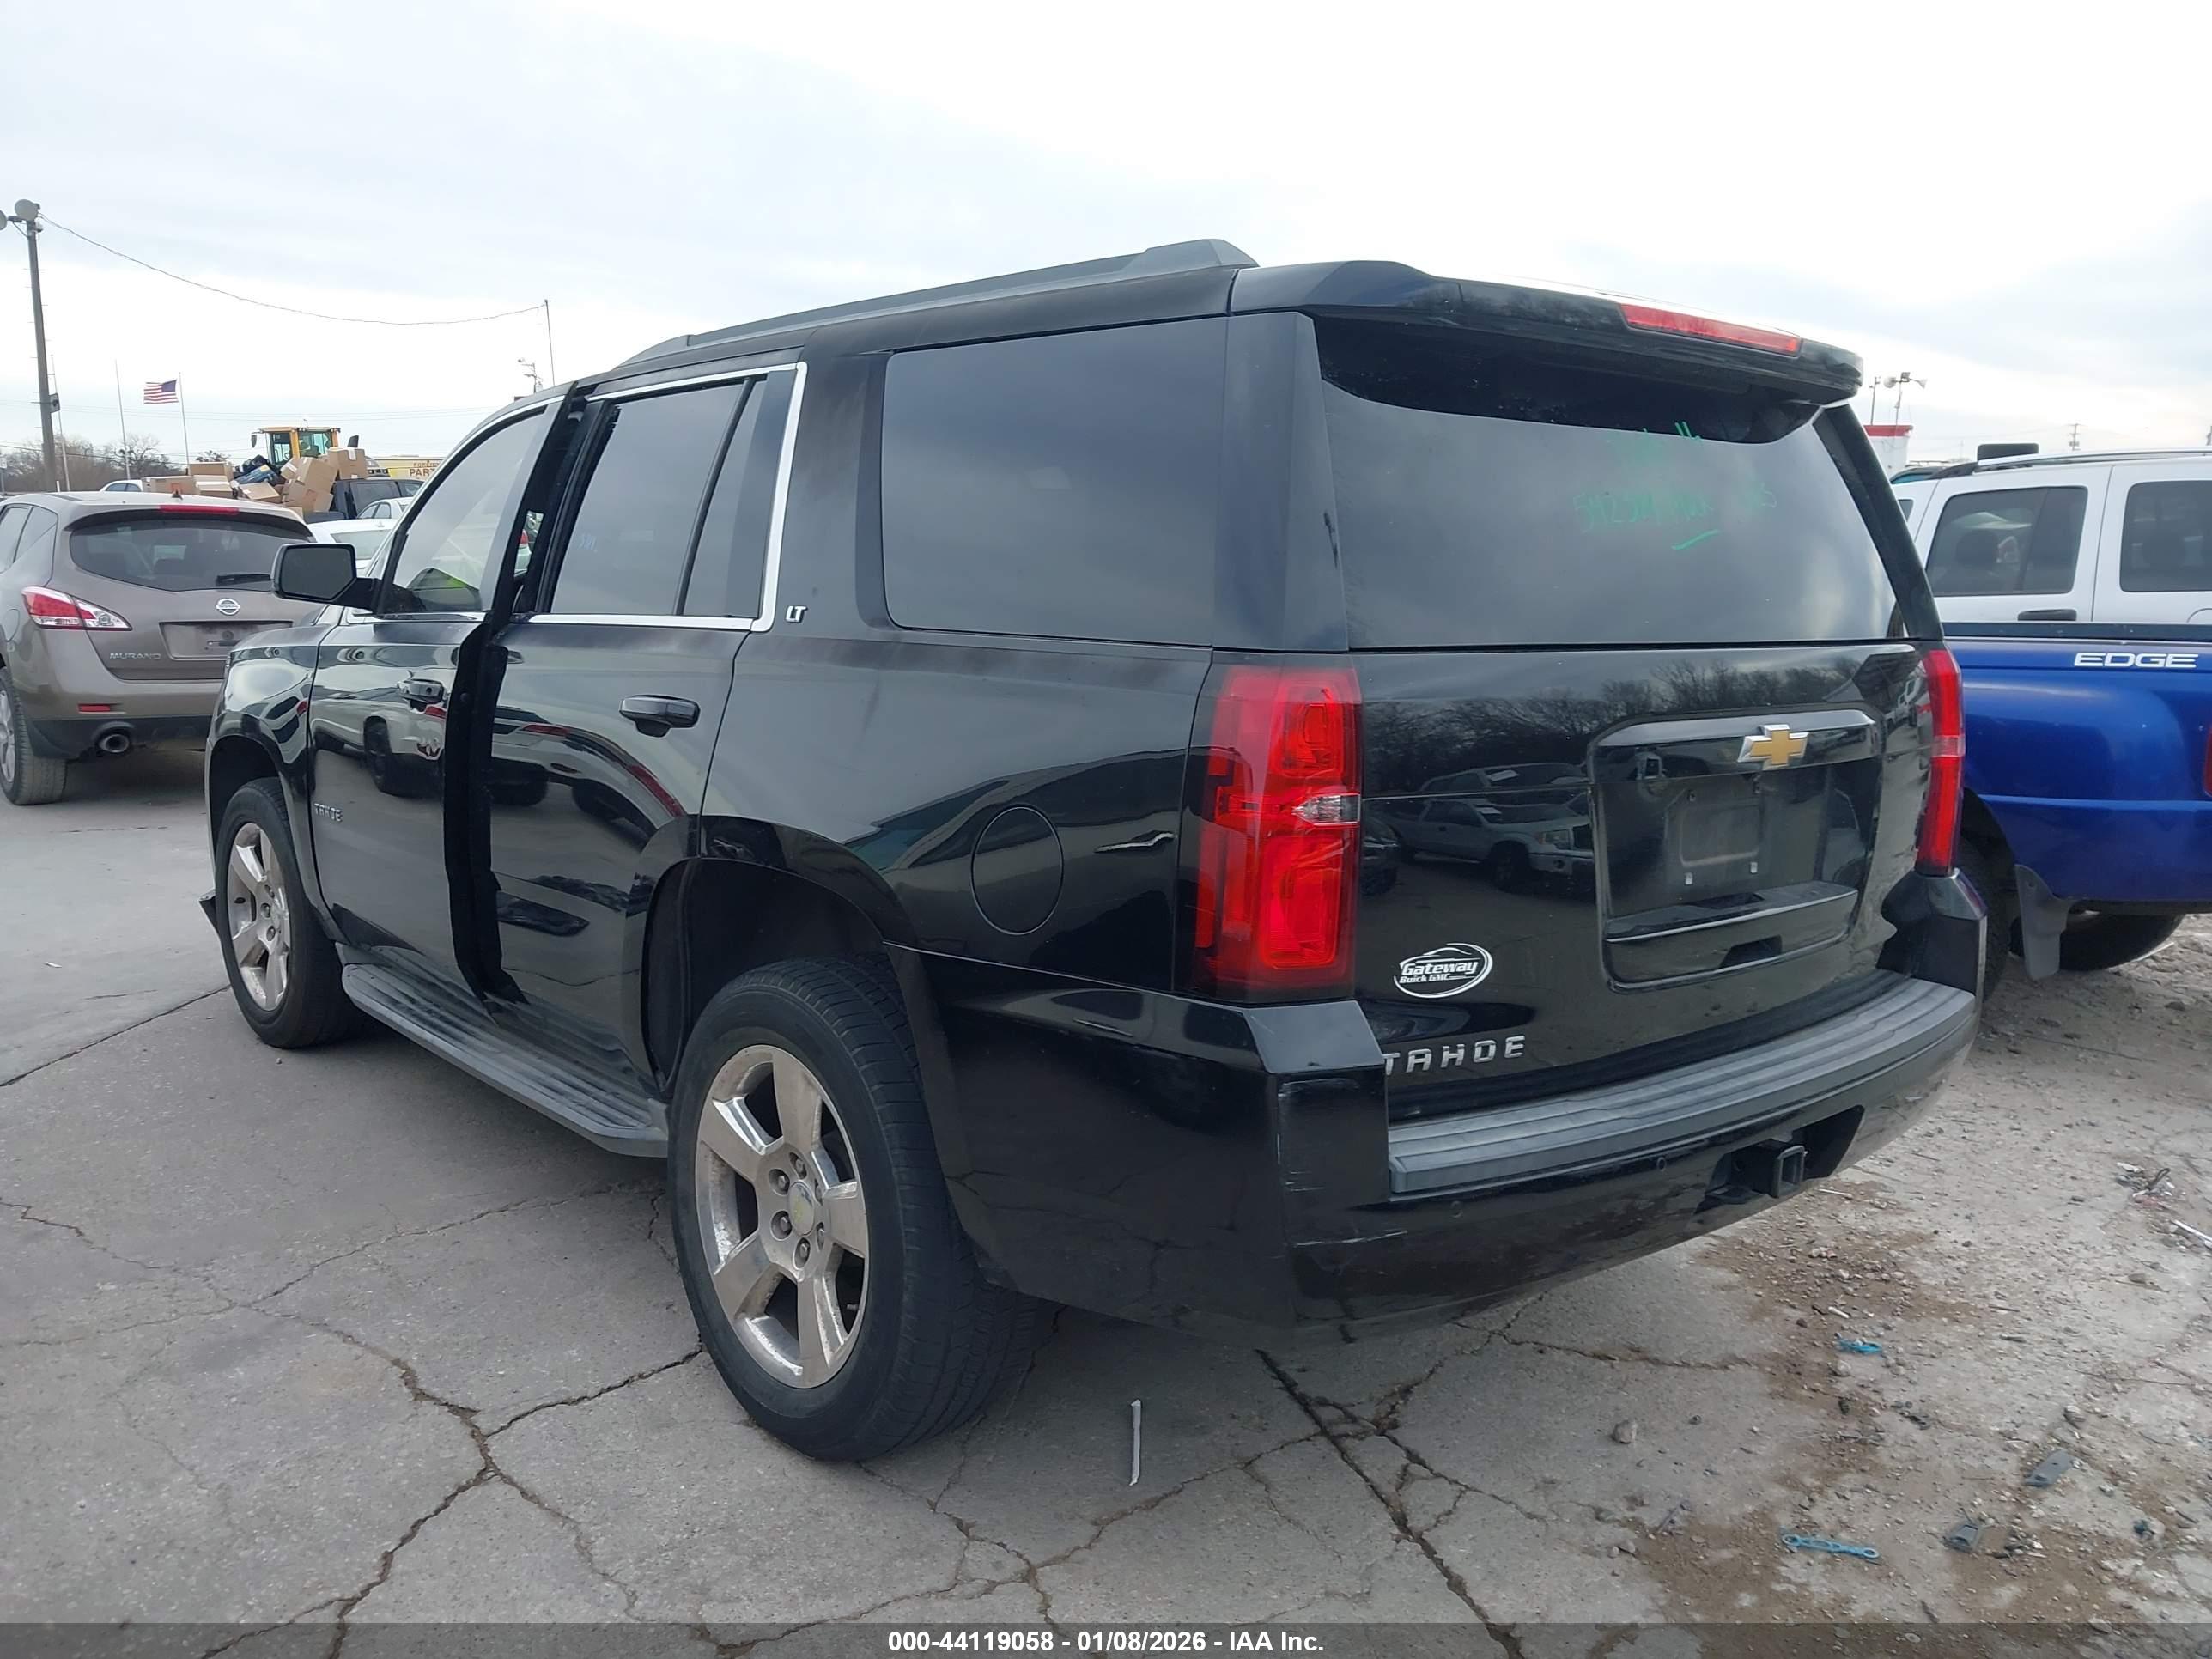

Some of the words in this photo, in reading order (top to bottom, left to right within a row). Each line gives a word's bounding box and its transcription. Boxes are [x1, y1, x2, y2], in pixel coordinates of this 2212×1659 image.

[786, 605, 807, 623] LT
[2074, 652, 2199, 668] EDGE
[313, 802, 343, 822] TAHOE
[1401, 961, 1479, 976] Gateway
[1399, 975, 1427, 984] Buick
[1429, 973, 1451, 981] GMC
[1382, 1035, 1526, 1076] TAHOE
